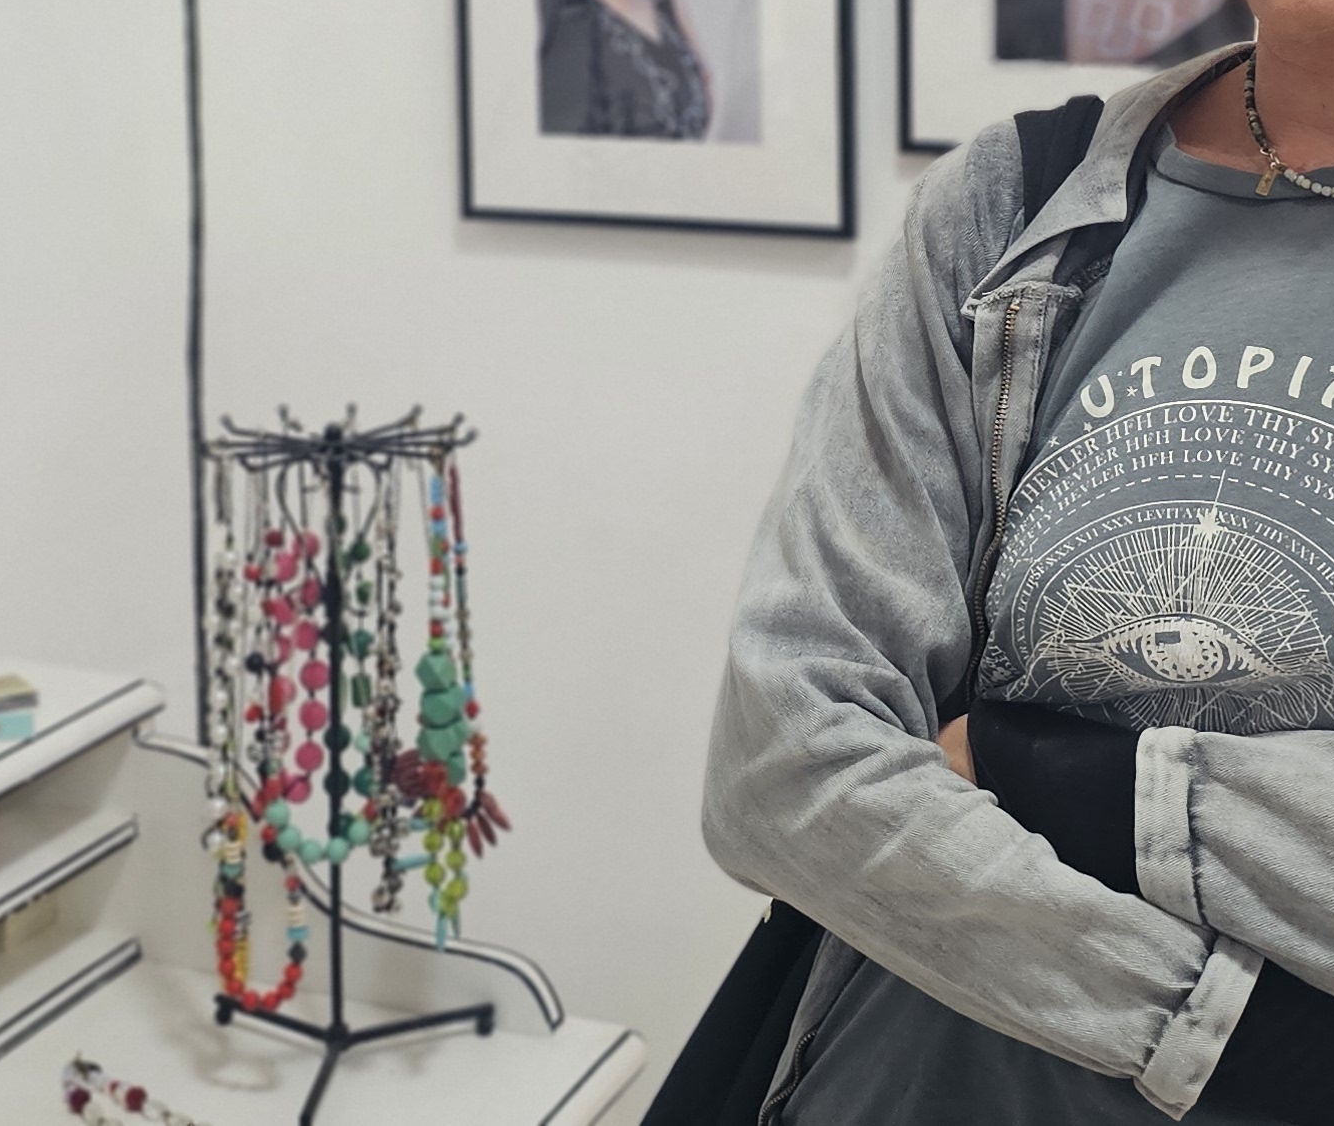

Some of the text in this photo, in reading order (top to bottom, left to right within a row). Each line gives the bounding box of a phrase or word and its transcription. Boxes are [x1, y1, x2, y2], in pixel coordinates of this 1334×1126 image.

[1020, 437, 1100, 503] HEVLER
[1106, 412, 1152, 444] HFH
[1163, 405, 1234, 425] LOVE
[1244, 408, 1303, 437] THY
[1049, 447, 1119, 501] HEVLER
[1126, 430, 1169, 453] HFH
[1180, 427, 1245, 444] LOVE
[1253, 432, 1305, 460] THY
[1057, 463, 1125, 511] HEVLER
[1132, 450, 1173, 470] HFH
[1183, 450, 1242, 466] LOVE
[1250, 455, 1298, 481] THY
[1255, 522, 1289, 545] THY
